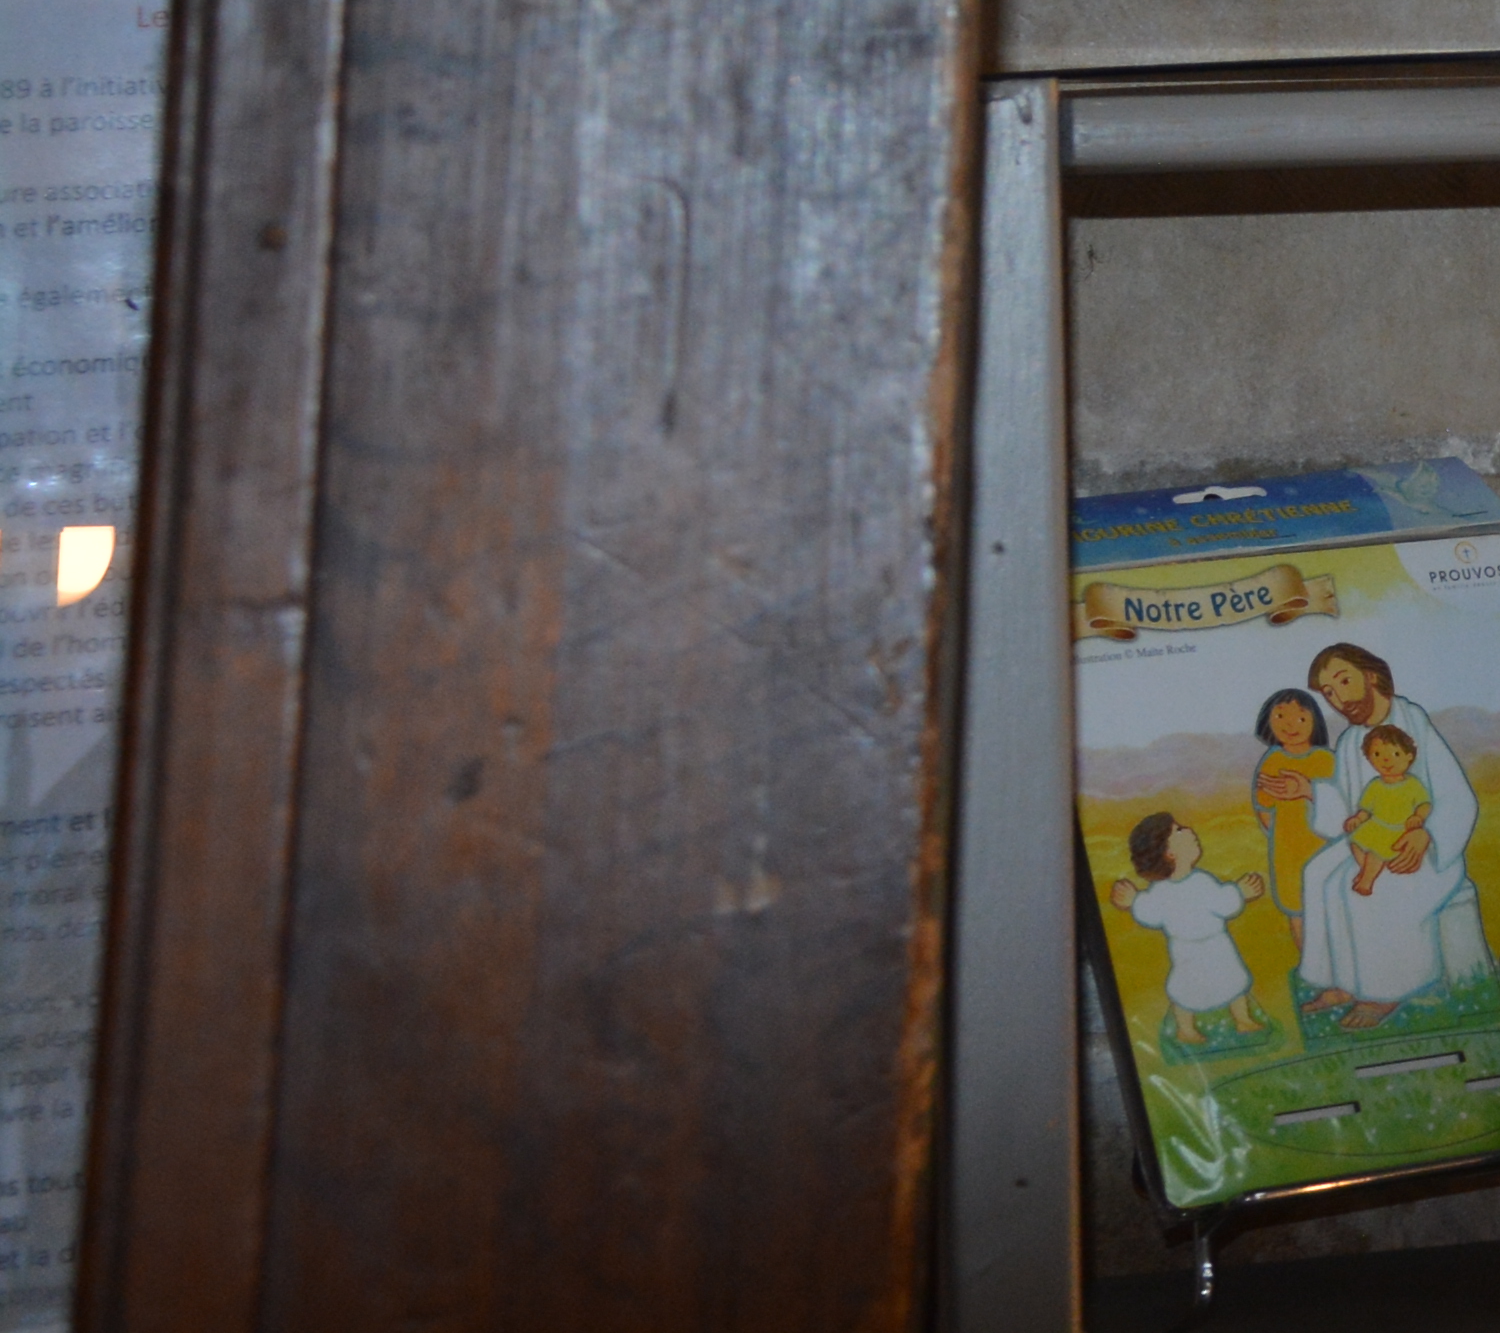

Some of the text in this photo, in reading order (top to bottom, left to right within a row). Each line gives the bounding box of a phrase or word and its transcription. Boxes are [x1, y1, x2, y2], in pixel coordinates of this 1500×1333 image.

[51, 110, 153, 135] paroisse
[1073, 499, 1358, 543] IGURINE CHRÉTIENNE
[1124, 586, 1273, 623] Notre Père
[1166, 641, 1197, 656] Roche
